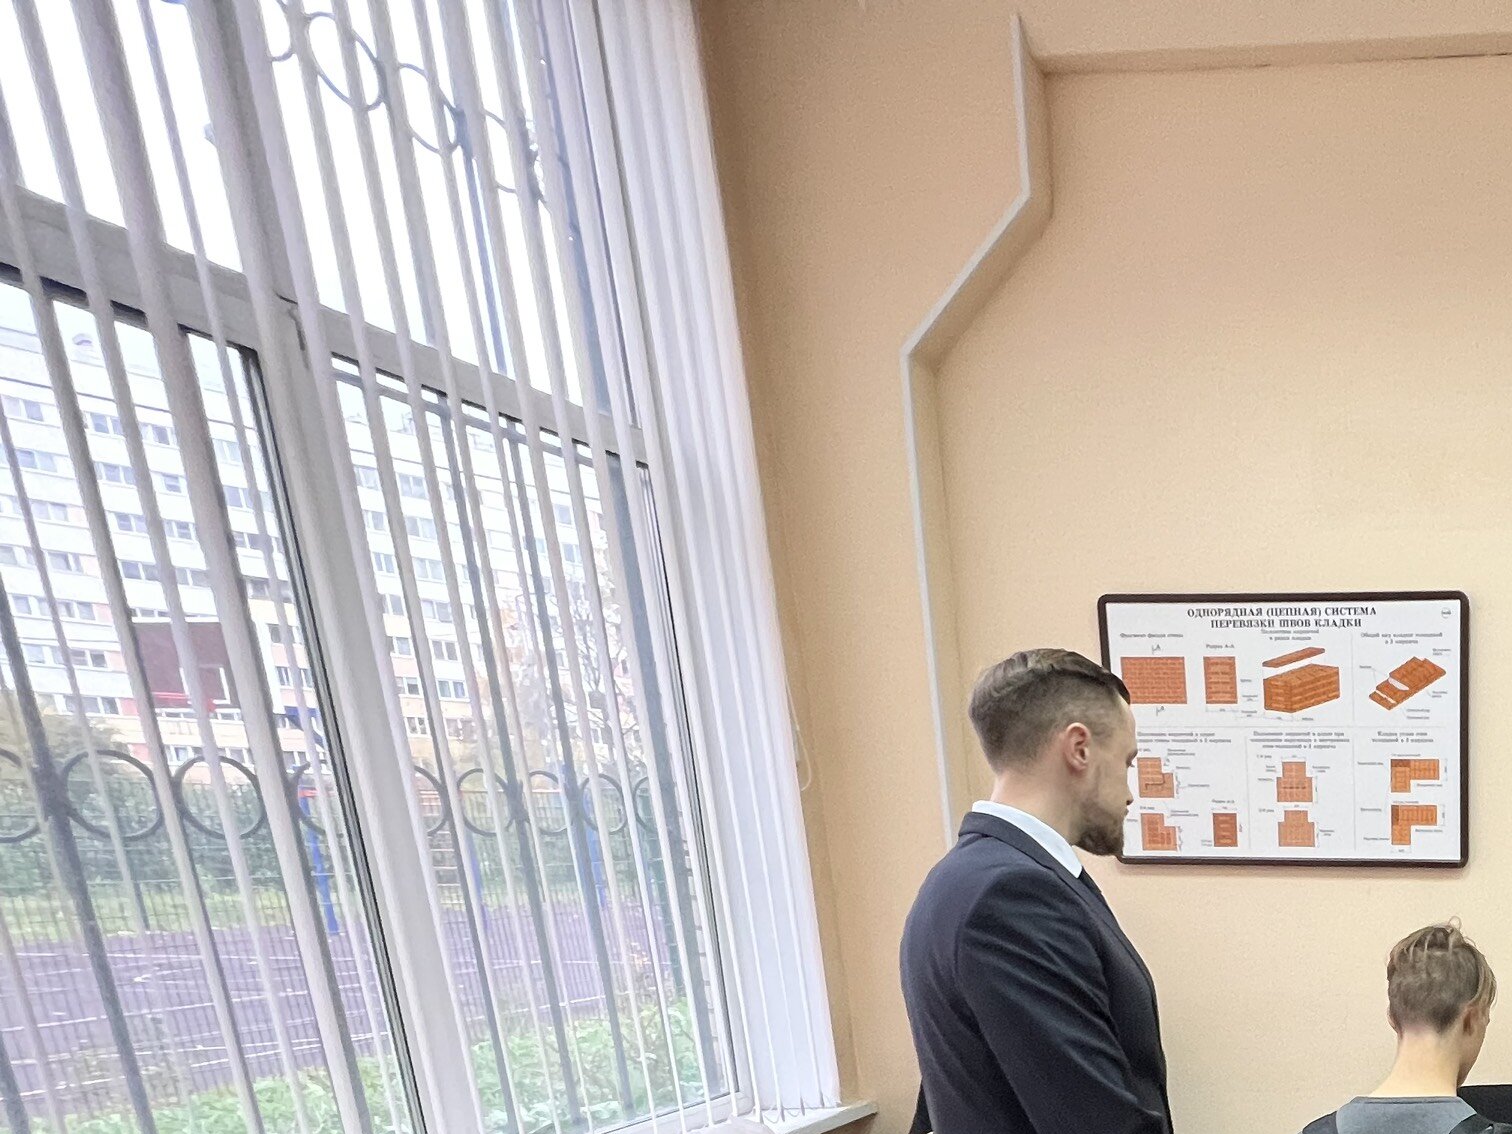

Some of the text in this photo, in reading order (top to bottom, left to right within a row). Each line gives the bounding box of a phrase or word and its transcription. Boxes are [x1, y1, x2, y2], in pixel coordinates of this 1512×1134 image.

[1187, 606, 1377, 618] ОДНОРЯДНАЯ (ЦЕПНАЯ) СИСТЕМА
[1211, 618, 1362, 629] ПЕРЕВЯЗКИ ШВОВ КЛАДКИ
